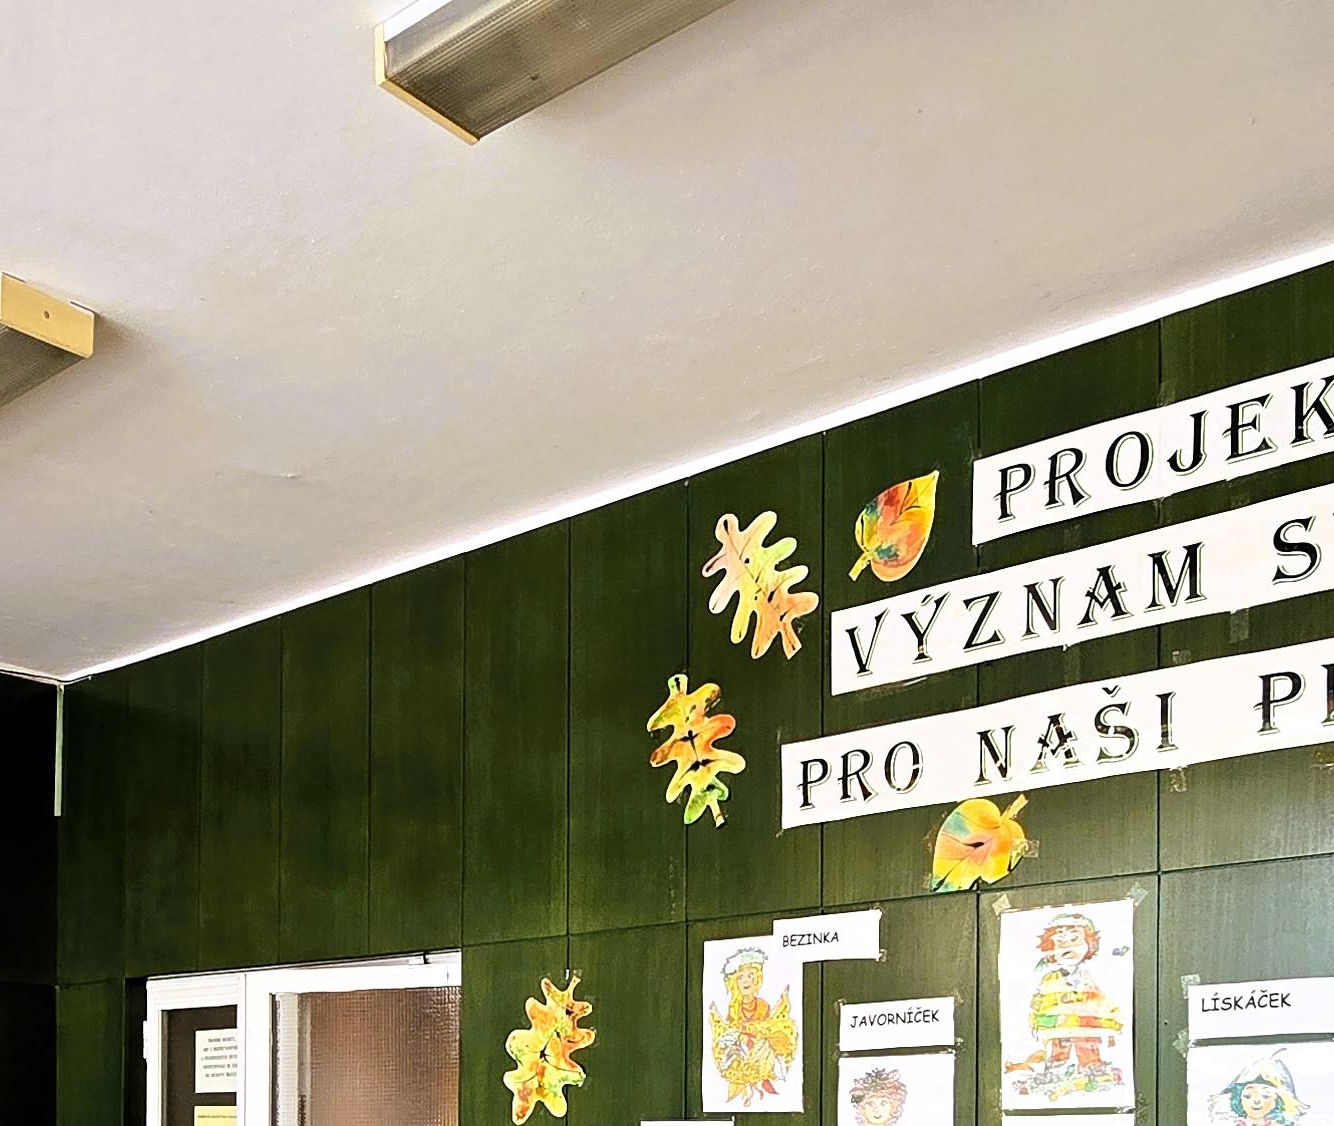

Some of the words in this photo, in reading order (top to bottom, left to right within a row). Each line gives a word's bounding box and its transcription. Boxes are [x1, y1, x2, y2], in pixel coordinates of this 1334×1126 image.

[844, 541, 1208, 677] VÝZNAM
[797, 740, 924, 810] PRO
[975, 687, 1178, 786] NAŠI
[782, 931, 839, 948] BEZINKA
[1201, 990, 1292, 1013] LÍSKÁČEK
[850, 1007, 940, 1029] JAVORNÍČEK
